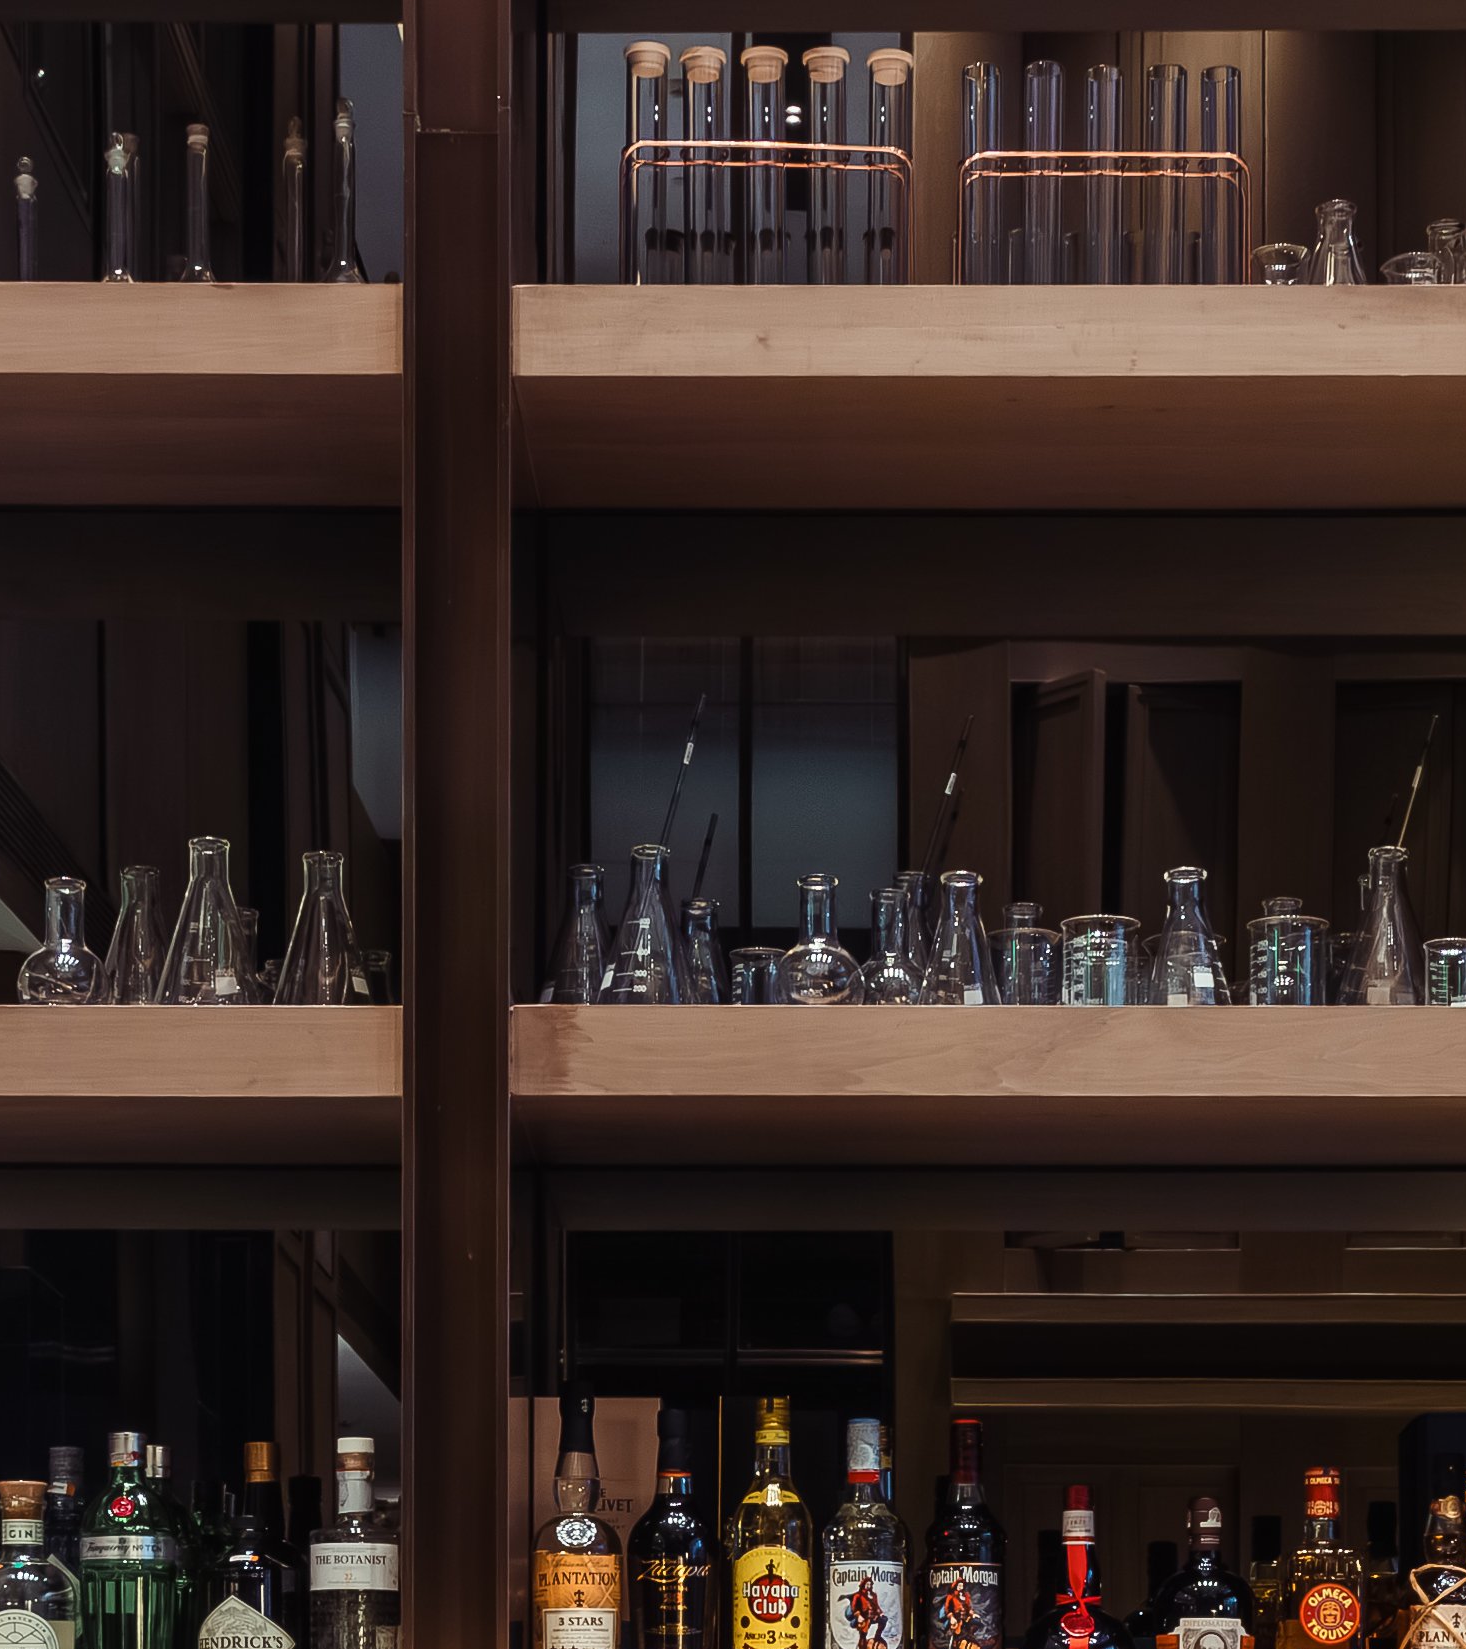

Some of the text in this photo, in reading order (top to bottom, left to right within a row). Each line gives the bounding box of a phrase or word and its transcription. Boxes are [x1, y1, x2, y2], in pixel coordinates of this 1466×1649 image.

[9, 1529, 33, 1539] GIN
[316, 1554, 387, 1566] THE BOTANIST
[538, 1570, 617, 1587] PLANTATION
[637, 1558, 711, 1583] Zacapa
[832, 1566, 901, 1586] Captain Morgan
[929, 1566, 998, 1588] Captain Morgan
[742, 1583, 800, 1599] Havana
[1307, 1587, 1353, 1609] OLMECA
[753, 1599, 788, 1615] Club
[558, 1616, 604, 1627] 3 STARS
[1307, 1618, 1355, 1640] TEQUILA
[766, 1630, 776, 1645] 3
